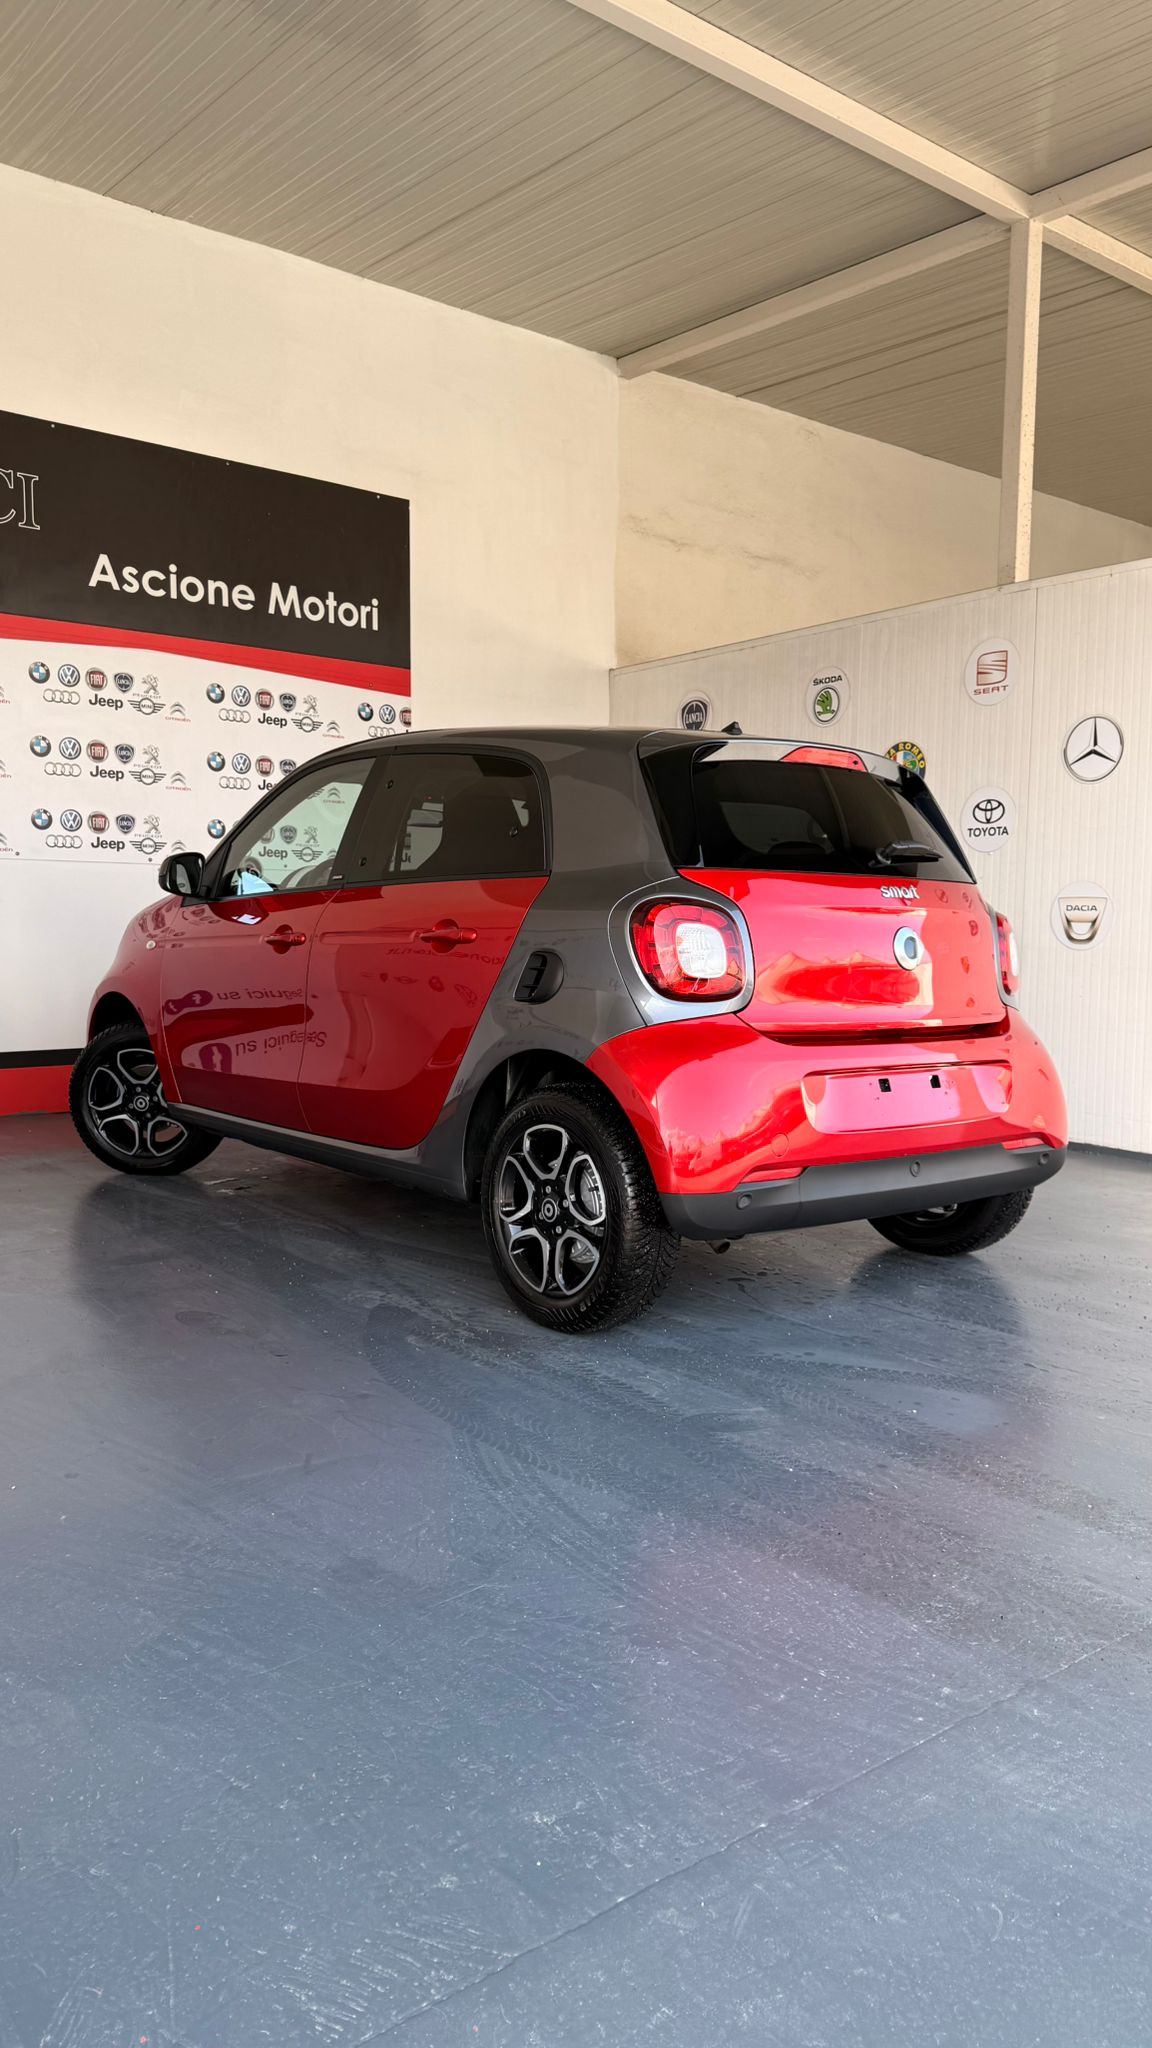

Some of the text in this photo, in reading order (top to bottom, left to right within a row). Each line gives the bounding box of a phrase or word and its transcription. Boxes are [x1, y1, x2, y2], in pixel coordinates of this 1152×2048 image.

[88, 553, 379, 631] Ascione Motori
[974, 685, 1008, 695] SEAT
[89, 694, 123, 710] Jeep
[258, 713, 287, 728] Jeep
[898, 743, 925, 768] ROMEO
[90, 766, 124, 781] Jeep
[967, 826, 1009, 838] TOYOTA
[91, 837, 125, 852] Jeep
[258, 846, 288, 860] Jeep
[881, 885, 920, 899] smart
[1066, 904, 1098, 912] DACIA
